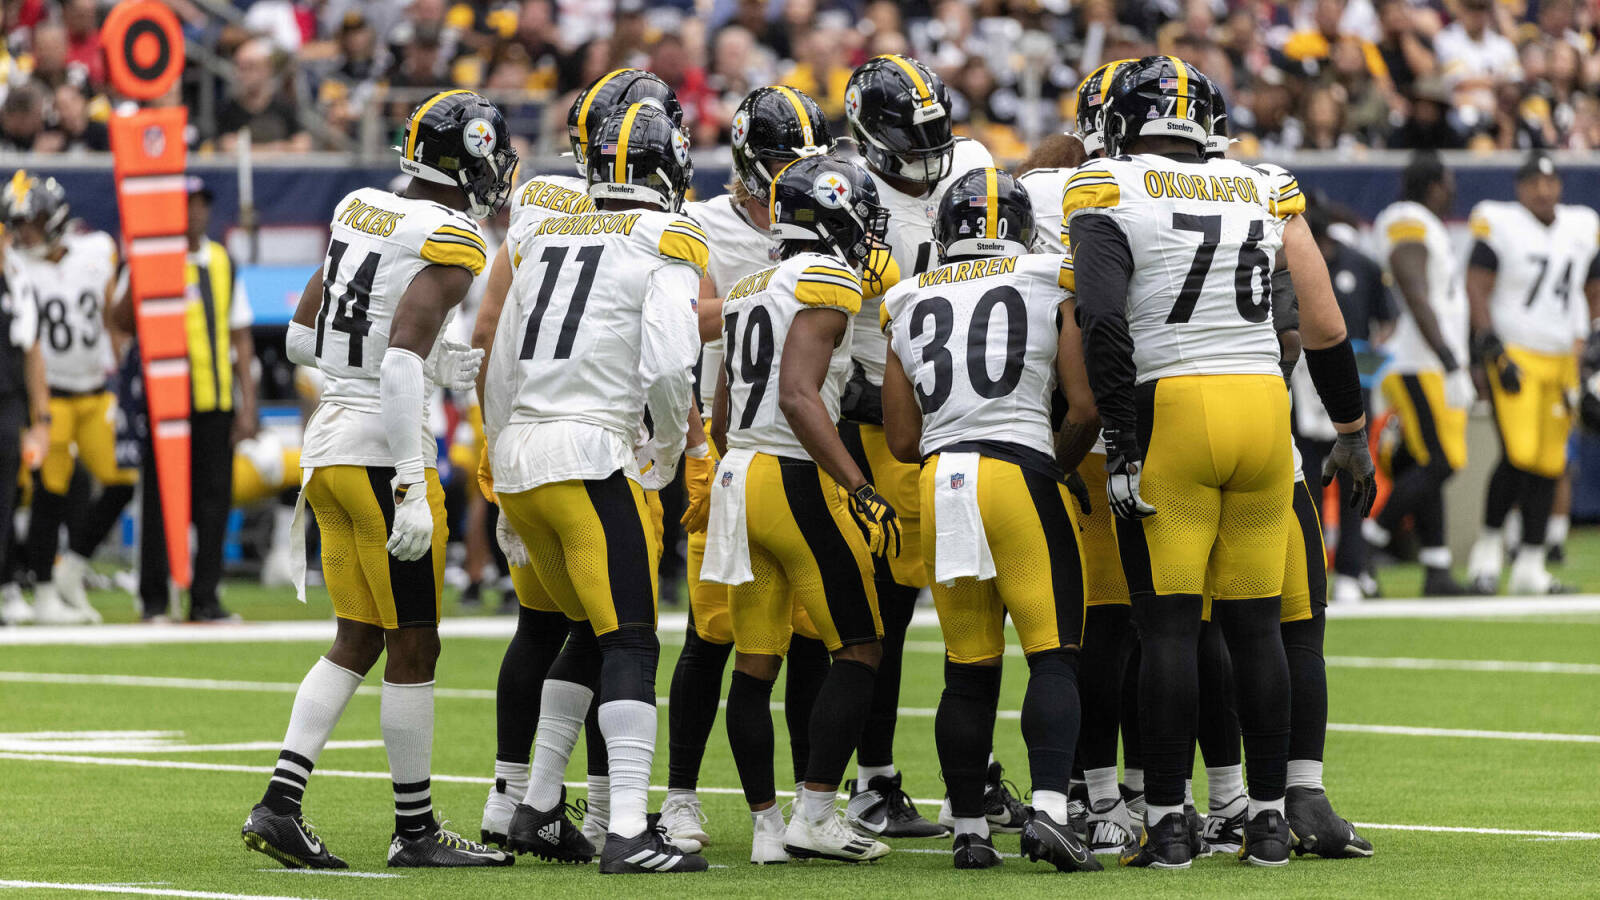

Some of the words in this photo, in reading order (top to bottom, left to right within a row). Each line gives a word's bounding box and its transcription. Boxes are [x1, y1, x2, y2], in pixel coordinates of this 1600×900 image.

[1095, 109, 1106, 131] 6
[1164, 97, 1196, 121] 76
[803, 125, 813, 145] 8
[1166, 121, 1193, 133] Steelers
[608, 161, 634, 184] 11
[607, 184, 635, 194] Steelers
[1144, 169, 1263, 206] OKORAFOR
[338, 198, 405, 237] PICKENS
[534, 213, 641, 237] ROBINSON
[975, 216, 1008, 239] 30
[976, 242, 1005, 251] Steelers
[918, 256, 1018, 288] WARREN
[1165, 212, 1272, 325] 76
[1524, 253, 1573, 310] 74
[315, 239, 382, 368] 14
[519, 245, 605, 360] 11
[44, 290, 97, 353] 83
[909, 285, 1028, 415] 30
[724, 305, 774, 437] 19
[537, 829, 560, 846] adidas
[1202, 816, 1227, 839] KE
